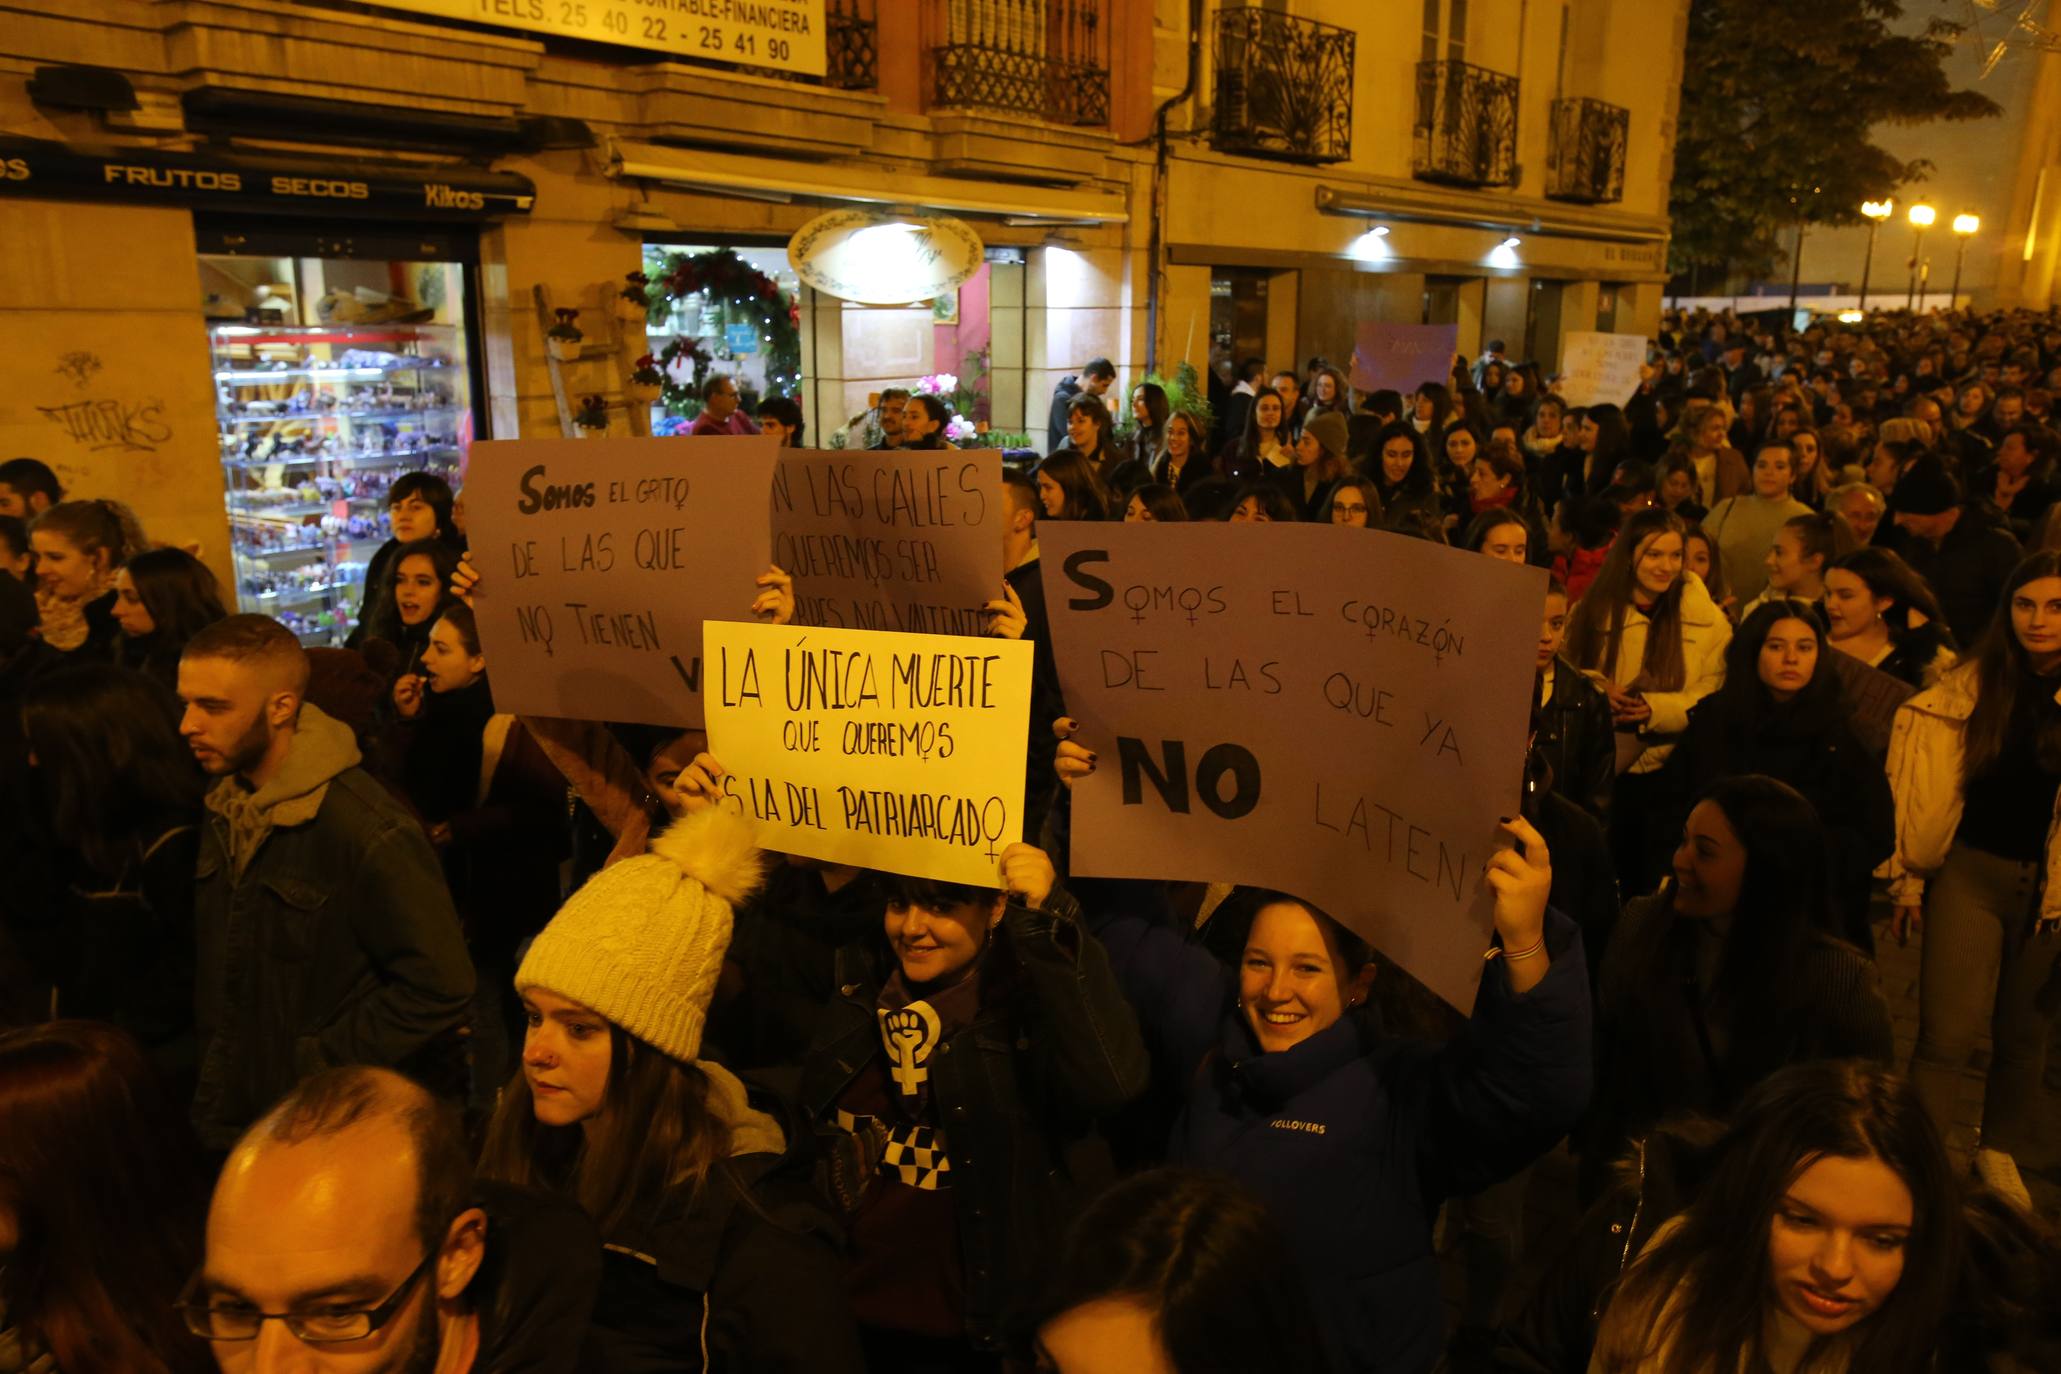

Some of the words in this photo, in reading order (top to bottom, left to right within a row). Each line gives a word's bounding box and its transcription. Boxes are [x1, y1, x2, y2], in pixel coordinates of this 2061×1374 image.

[561, 1, 588, 28] 25
[602, 8, 628, 34] 40
[642, 15, 668, 41] 22
[700, 26, 725, 50] 25
[734, 31, 757, 55] 41
[768, 38, 791, 61] 90
[104, 164, 242, 192] FRUTOS
[271, 176, 369, 199] SECOS
[424, 184, 485, 210] Kikos
[608, 481, 630, 503] EL
[636, 477, 690, 511] GRITO
[771, 463, 794, 513] N
[806, 463, 864, 519] LAS
[873, 463, 986, 528] CALLES
[511, 541, 540, 579] DE
[561, 532, 615, 572] LAS
[634, 527, 686, 571] QUE
[775, 531, 893, 588] QUEREMOS
[898, 539, 942, 584] SER
[516, 605, 554, 657] NO
[1272, 591, 1315, 616] EL
[1341, 600, 1465, 667] CORAZÓN
[721, 646, 763, 708] LA
[784, 635, 879, 712] ÚNICA
[892, 654, 1002, 710] MUERTE
[1101, 649, 1166, 691] DE
[1205, 656, 1283, 695] LAS
[1323, 672, 1395, 728] QUE
[1419, 711, 1464, 767] YA
[783, 719, 820, 754] QUE
[843, 720, 955, 764] QUEREMOS
[722, 774, 745, 817] S
[748, 776, 781, 822] LA
[783, 781, 828, 831] DEL
[837, 783, 1007, 865] PATRIARCADO
[1116, 735, 1261, 821] NO
[1315, 782, 1468, 903] LATEN
